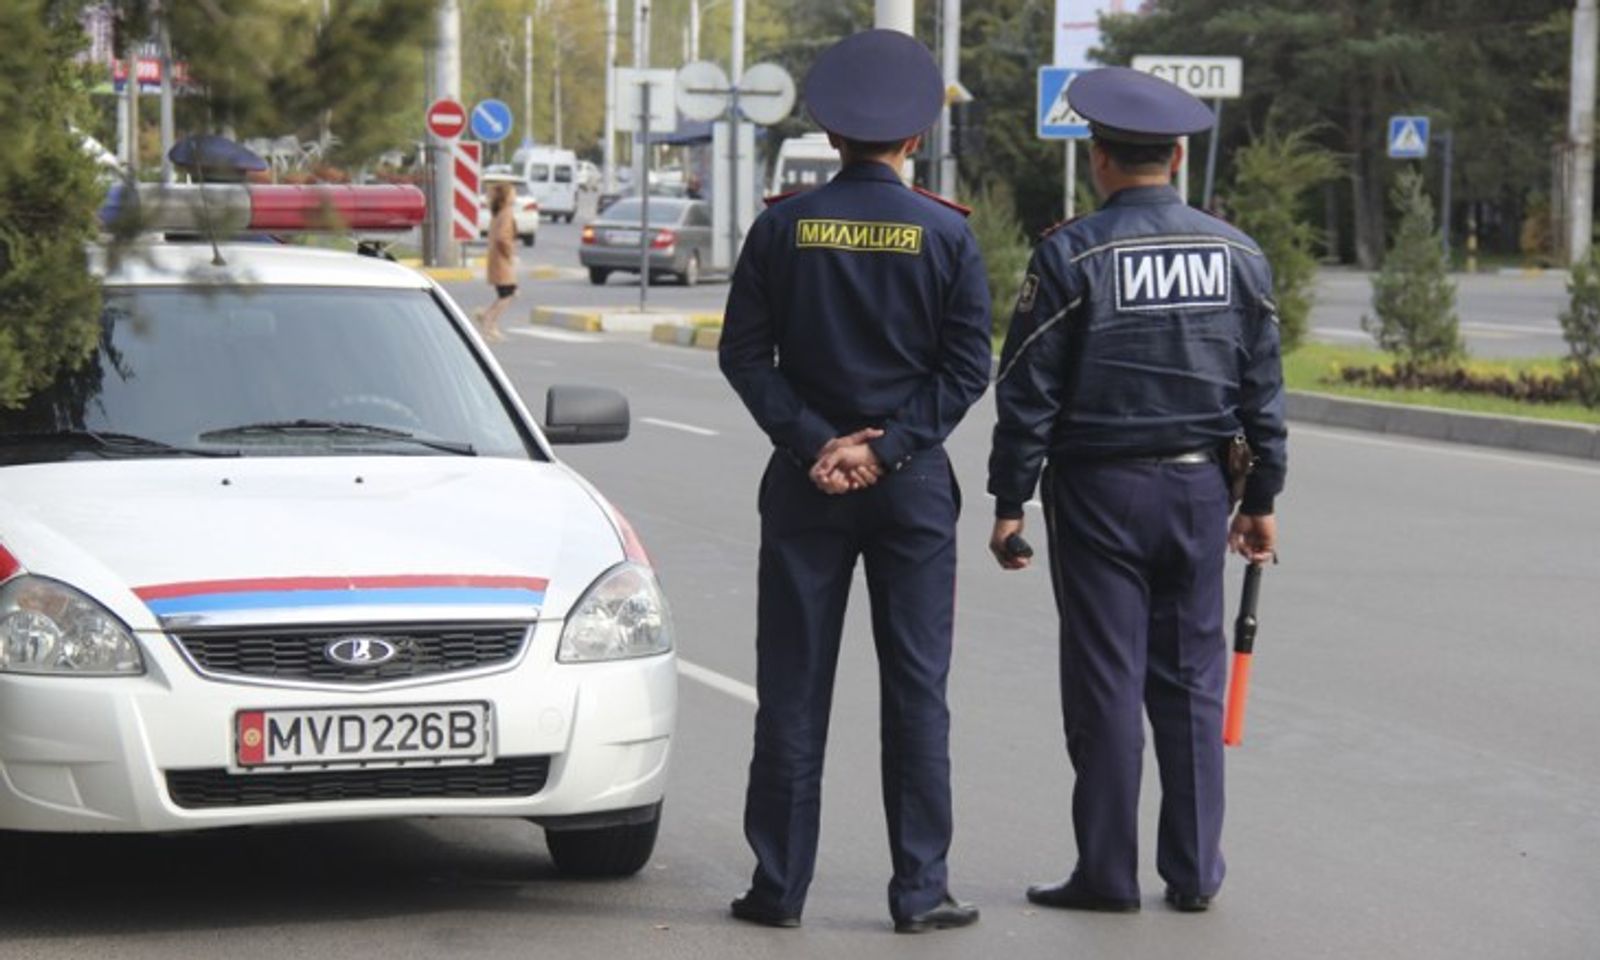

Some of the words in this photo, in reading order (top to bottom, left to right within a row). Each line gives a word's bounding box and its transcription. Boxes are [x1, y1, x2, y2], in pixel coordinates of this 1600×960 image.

[801, 223, 917, 248] МИЛИЦИЯ
[1123, 252, 1225, 300] ИИМ
[268, 711, 476, 756] MVD226B
